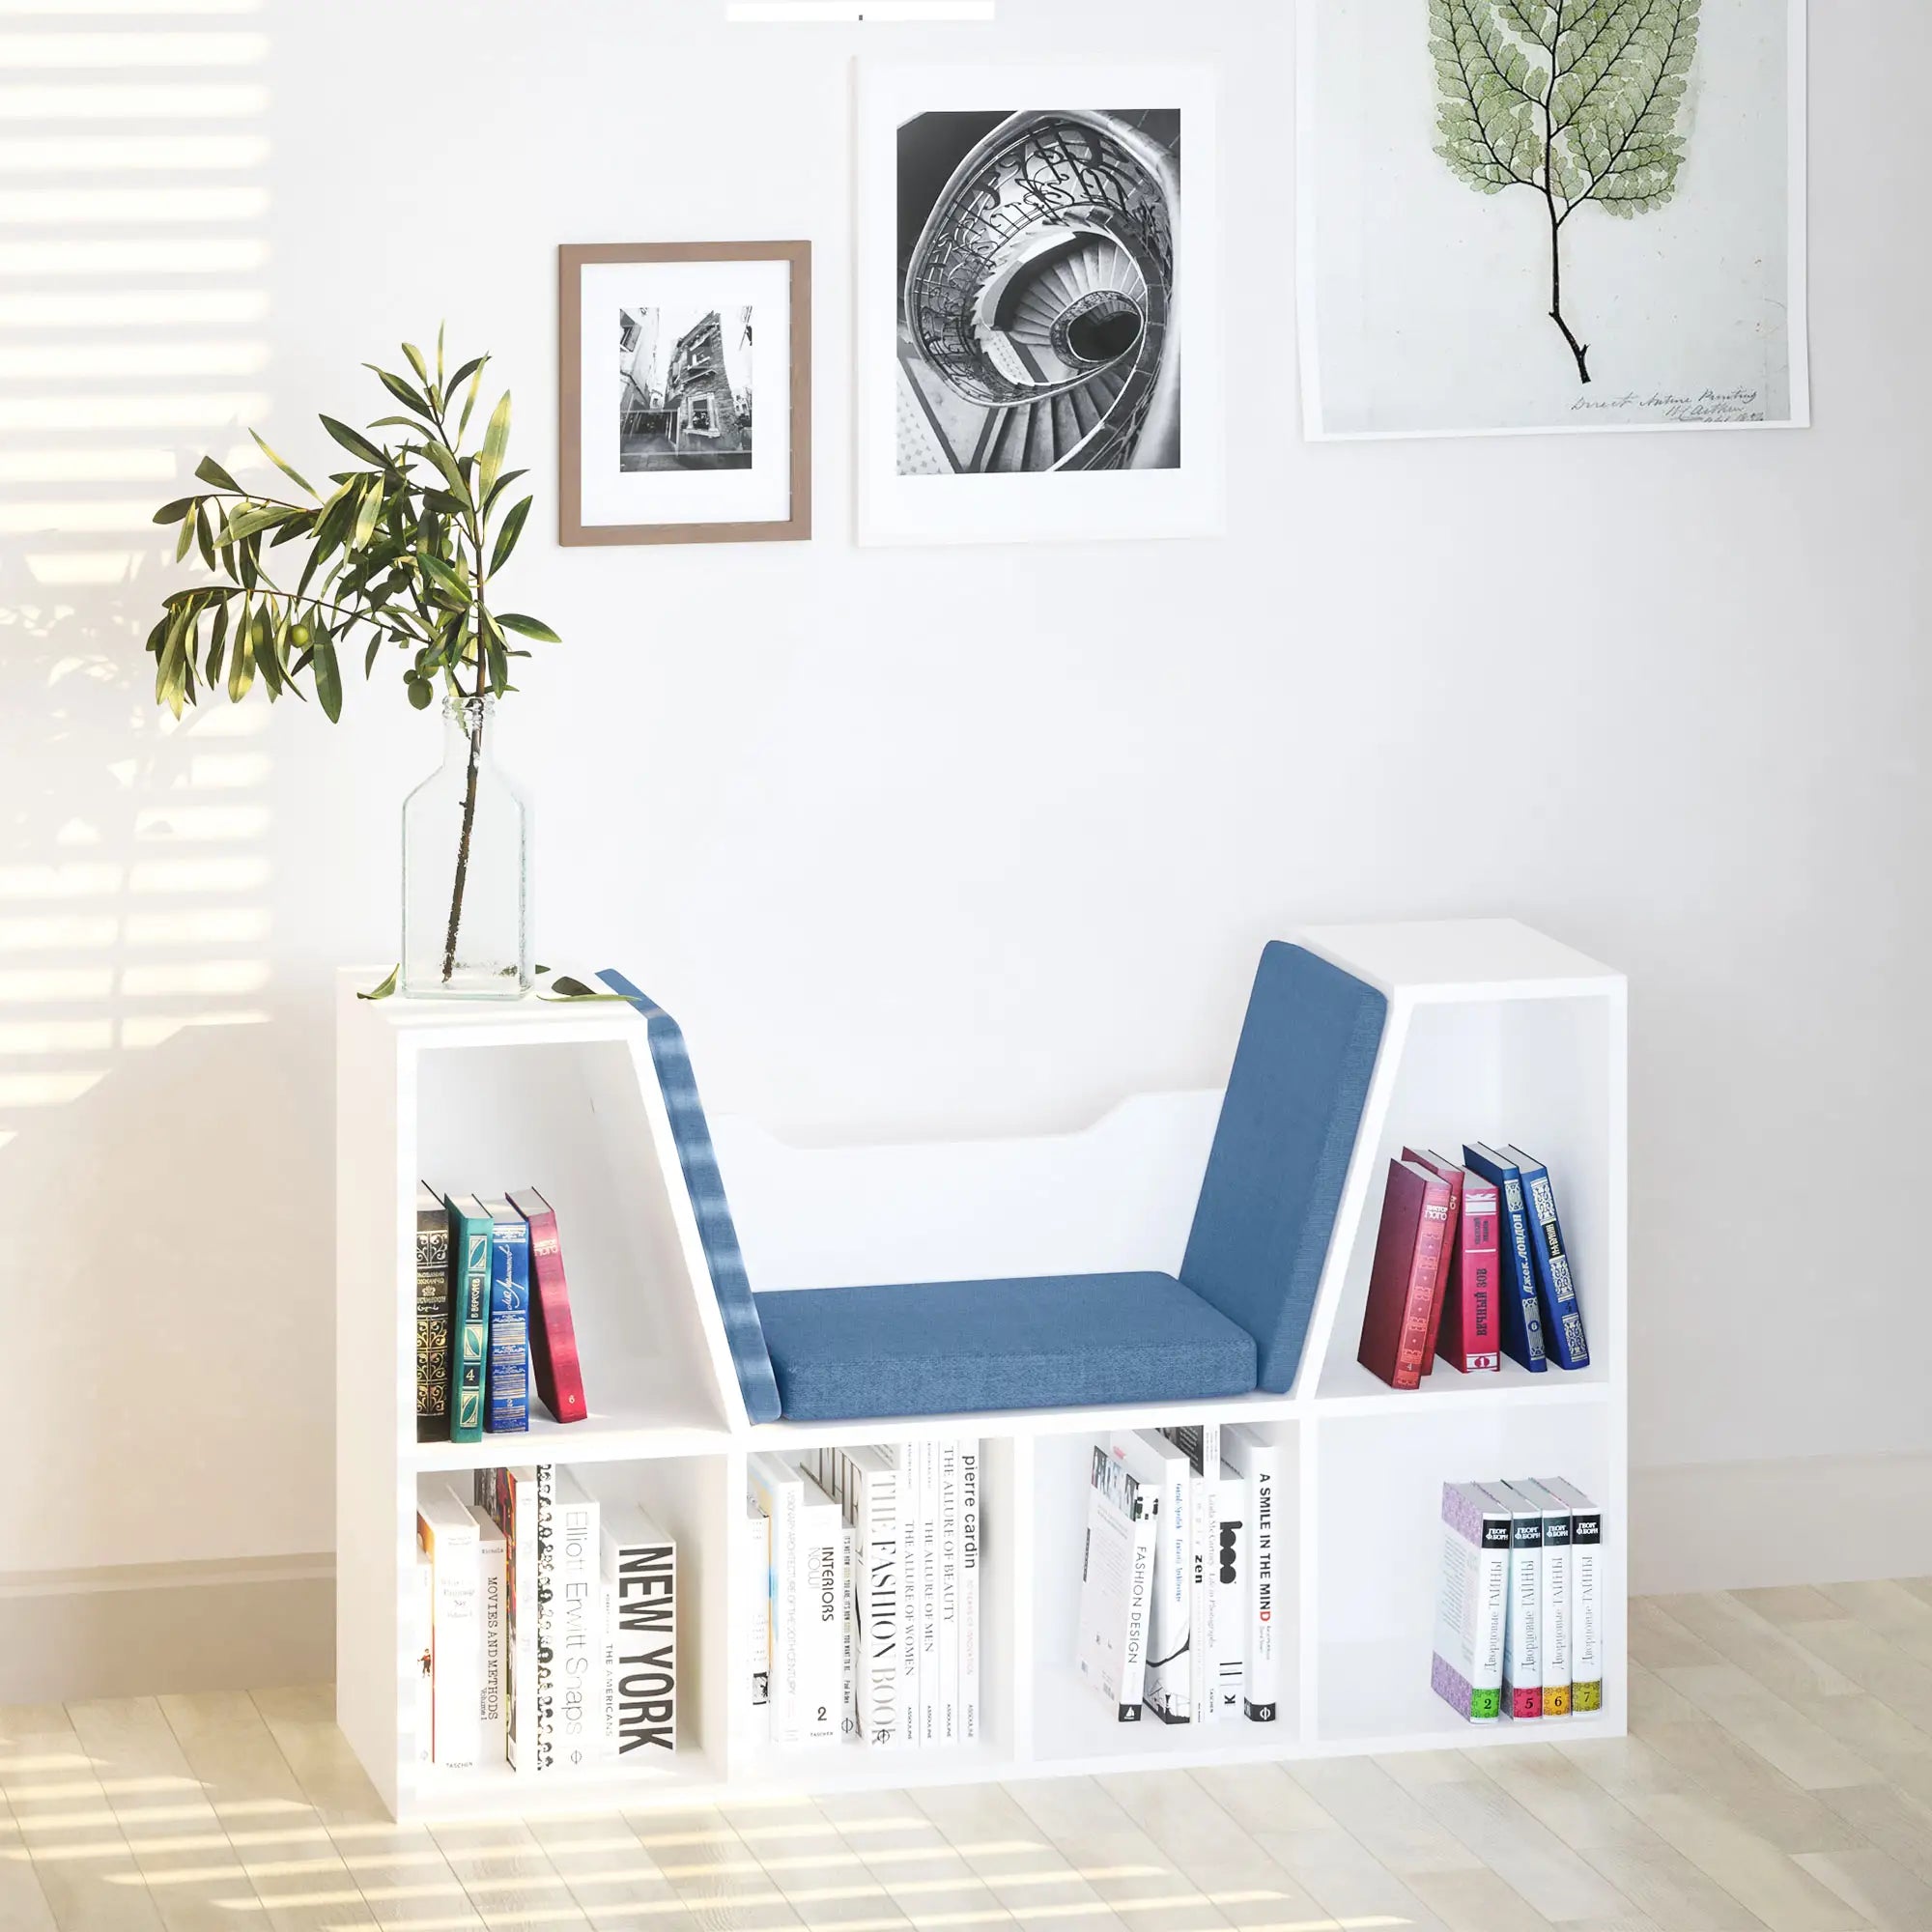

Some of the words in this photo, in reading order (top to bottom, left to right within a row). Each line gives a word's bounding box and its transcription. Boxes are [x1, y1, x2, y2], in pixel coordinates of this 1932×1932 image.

[1571, 391, 1639, 411] Direct
[1512, 1214, 1527, 1262] ЛОНДОН
[1476, 1268, 1488, 1288] ЗОВ
[1521, 1262, 1534, 1295] Джек
[1474, 1292, 1488, 1336] ВЕЧНЫЙ
[1530, 1321, 1538, 1331] 6
[466, 1369, 474, 1381] 4
[944, 1446, 954, 1477] THE
[961, 1455, 976, 1507] pierre
[1260, 1473, 1271, 1483] A
[871, 1474, 895, 1533] THE
[944, 1480, 954, 1538] ALLURE
[1260, 1488, 1271, 1530] SMILE
[904, 1520, 915, 1547] THE
[924, 1520, 934, 1547] THE
[944, 1541, 954, 1560] OF
[964, 1513, 978, 1569] cardin
[1260, 1534, 1271, 1549] IN
[821, 1547, 834, 1622] INTERIORS
[904, 1549, 915, 1601] ALLURE
[924, 1549, 934, 1600] ALLURE
[1132, 1546, 1148, 1607] FASHION
[1194, 1554, 1204, 1584] zen
[1260, 1552, 1271, 1579] THE
[1488, 1561, 1502, 1607] ТАЙНЫ
[1520, 1560, 1534, 1607] ТАЙНЫ
[487, 1577, 498, 1628] MOVIES
[618, 1547, 673, 1633] NEW
[871, 1541, 895, 1659] FASHION
[944, 1564, 954, 1624] BEAUTY
[1260, 1583, 1271, 1622] MIND
[565, 1581, 588, 1649] Erwitt
[904, 1604, 915, 1621] OF
[924, 1603, 934, 1620] OF
[487, 1630, 498, 1658] AND
[605, 1644, 613, 1665] THE
[904, 1625, 915, 1676] WOMEN
[924, 1623, 934, 1653] MEN
[1127, 1611, 1143, 1664] DESIGN
[1484, 1610, 1500, 1672] Дворцовые
[1521, 1610, 1536, 1672] Дворцовые
[487, 1659, 498, 1720] METHODS
[561, 1657, 588, 1736] Snaps
[605, 1670, 613, 1737] AMERICANS
[618, 1644, 674, 1754] YORK
[1224, 1694, 1236, 1705] K
[1484, 1699, 1492, 1710] 2
[1525, 1698, 1534, 1709] 5
[1554, 1696, 1562, 1707] 6
[1583, 1691, 1590, 1703] 7
[817, 1706, 827, 1721] 2
